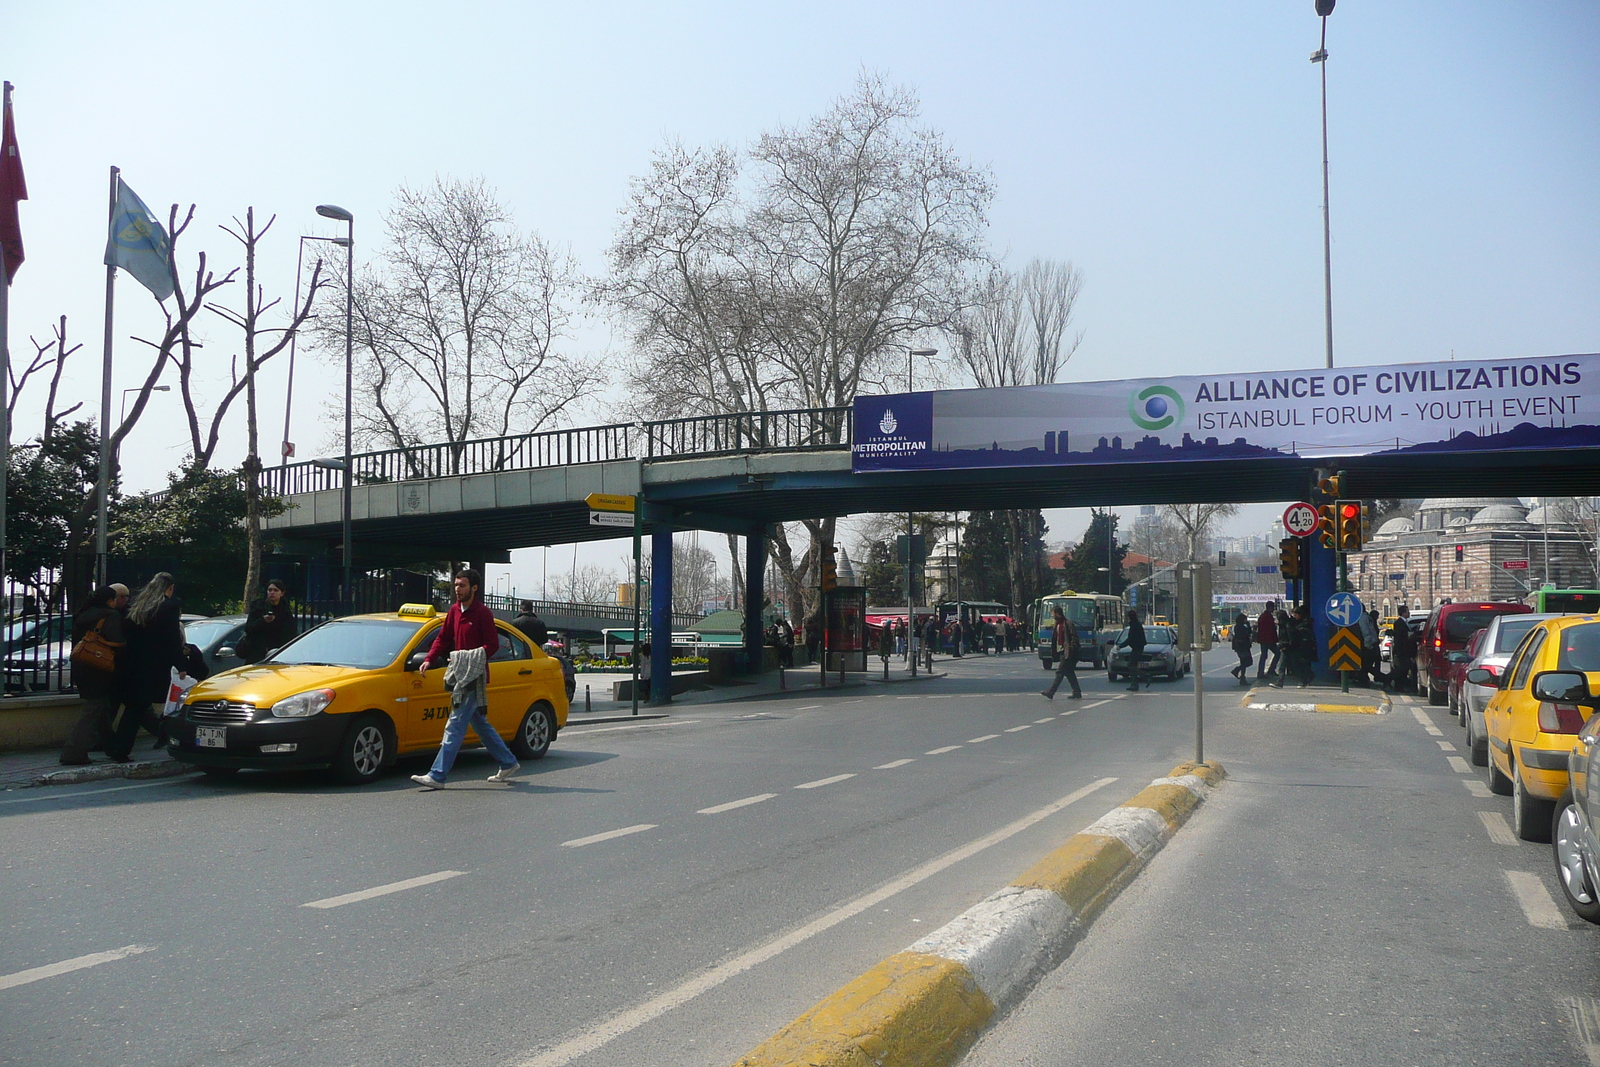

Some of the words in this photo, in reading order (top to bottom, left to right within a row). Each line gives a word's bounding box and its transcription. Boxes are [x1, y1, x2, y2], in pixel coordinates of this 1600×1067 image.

[1195, 376, 1325, 403] ALLIANCE
[1333, 374, 1368, 396] OF
[1375, 362, 1581, 394] CIVILIZATIONS
[1198, 408, 1306, 430] ISTANBUL
[1312, 404, 1392, 425] FORUM
[1416, 399, 1493, 421] YOUTH
[1503, 395, 1581, 417] EVENT
[851, 441, 926, 452] METROPOLITAN
[1289, 510, 1300, 527] 4
[422, 708, 435, 721] 34
[198, 729, 206, 737] 34
[211, 729, 224, 738] TJN
